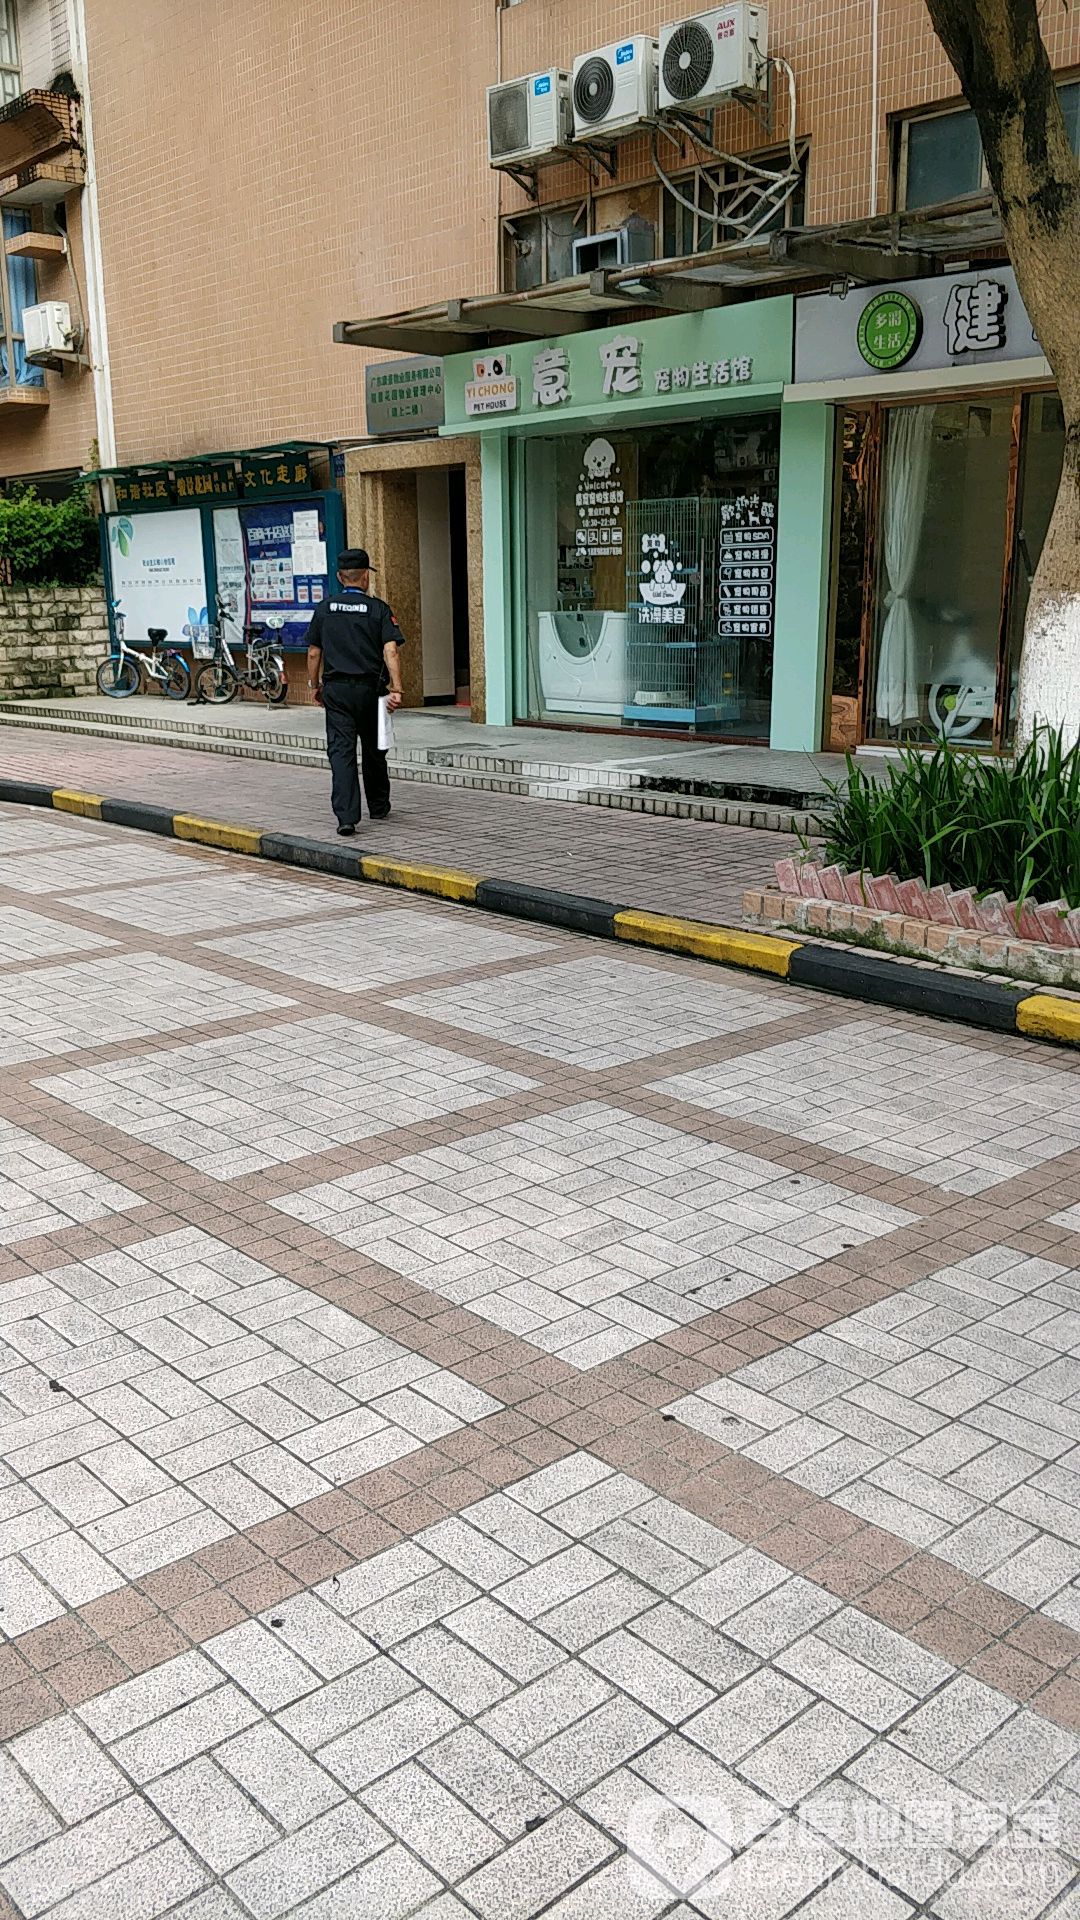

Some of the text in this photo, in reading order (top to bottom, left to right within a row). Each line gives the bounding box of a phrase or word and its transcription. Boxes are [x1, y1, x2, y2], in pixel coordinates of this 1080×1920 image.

[716, 18, 736, 30] AUX
[943, 280, 1007, 355] 健
[654, 355, 753, 391] 宠物生活馆
[466, 381, 514, 398] YI CHONG
[486, 399, 507, 410] HOUSE
[115, 480, 168, 501] 和谐社区
[244, 464, 308, 488] 文化走廊
[638, 607, 685, 624] 洗澡美容
